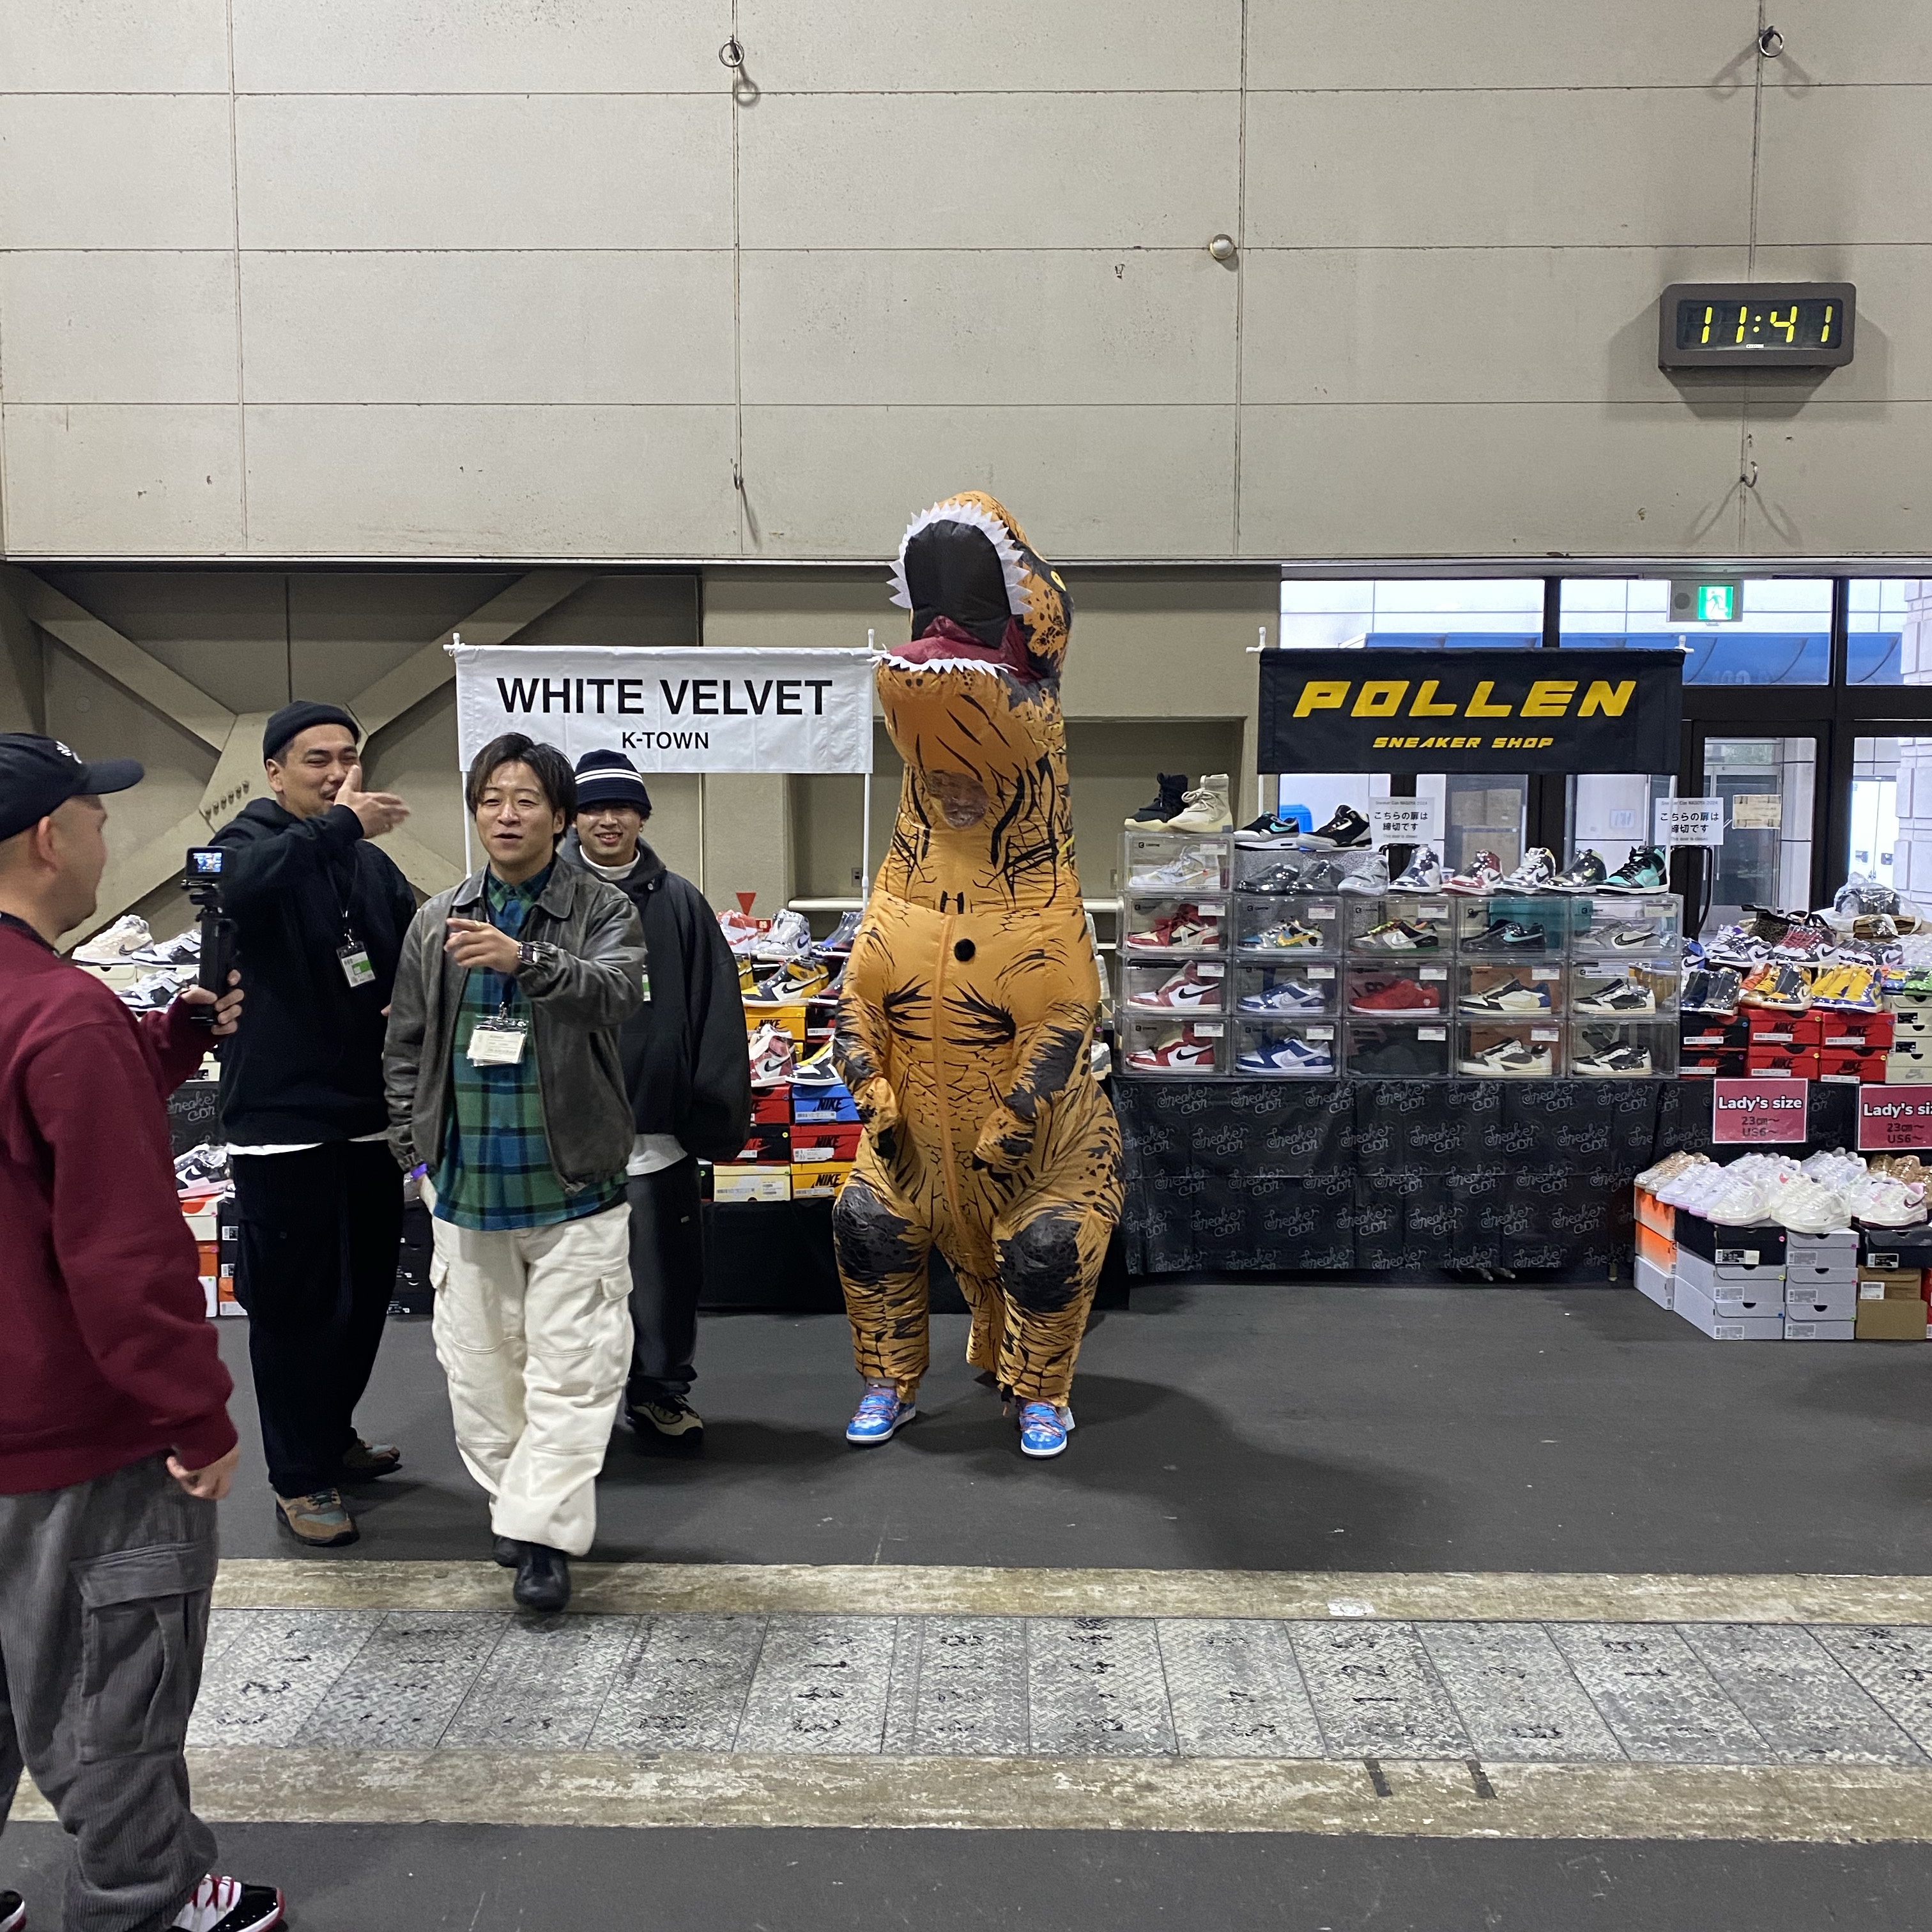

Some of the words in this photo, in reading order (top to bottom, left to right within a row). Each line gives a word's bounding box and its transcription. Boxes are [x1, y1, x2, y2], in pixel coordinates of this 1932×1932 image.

[1701, 305, 1833, 343] 11:41
[497, 677, 644, 715] WHITE
[659, 679, 833, 716] VELVET
[1292, 680, 1637, 717] POLLEN
[622, 731, 709, 750] K-TOWN
[1372, 737, 1481, 749] SNEAKER
[1491, 737, 1554, 749] SHOP
[1374, 811, 1428, 820] こちらの扉は
[1660, 812, 1719, 821] こちらの扉は
[1383, 822, 1418, 831] 締切です
[817, 1098, 842, 1111] NIKE
[1718, 1096, 1769, 1112] Lady's
[1772, 1095, 1802, 1109] size
[1863, 1102, 1914, 1119] Lady's
[1917, 1101, 1932, 1116] si
[815, 1174, 841, 1186] NIKE
